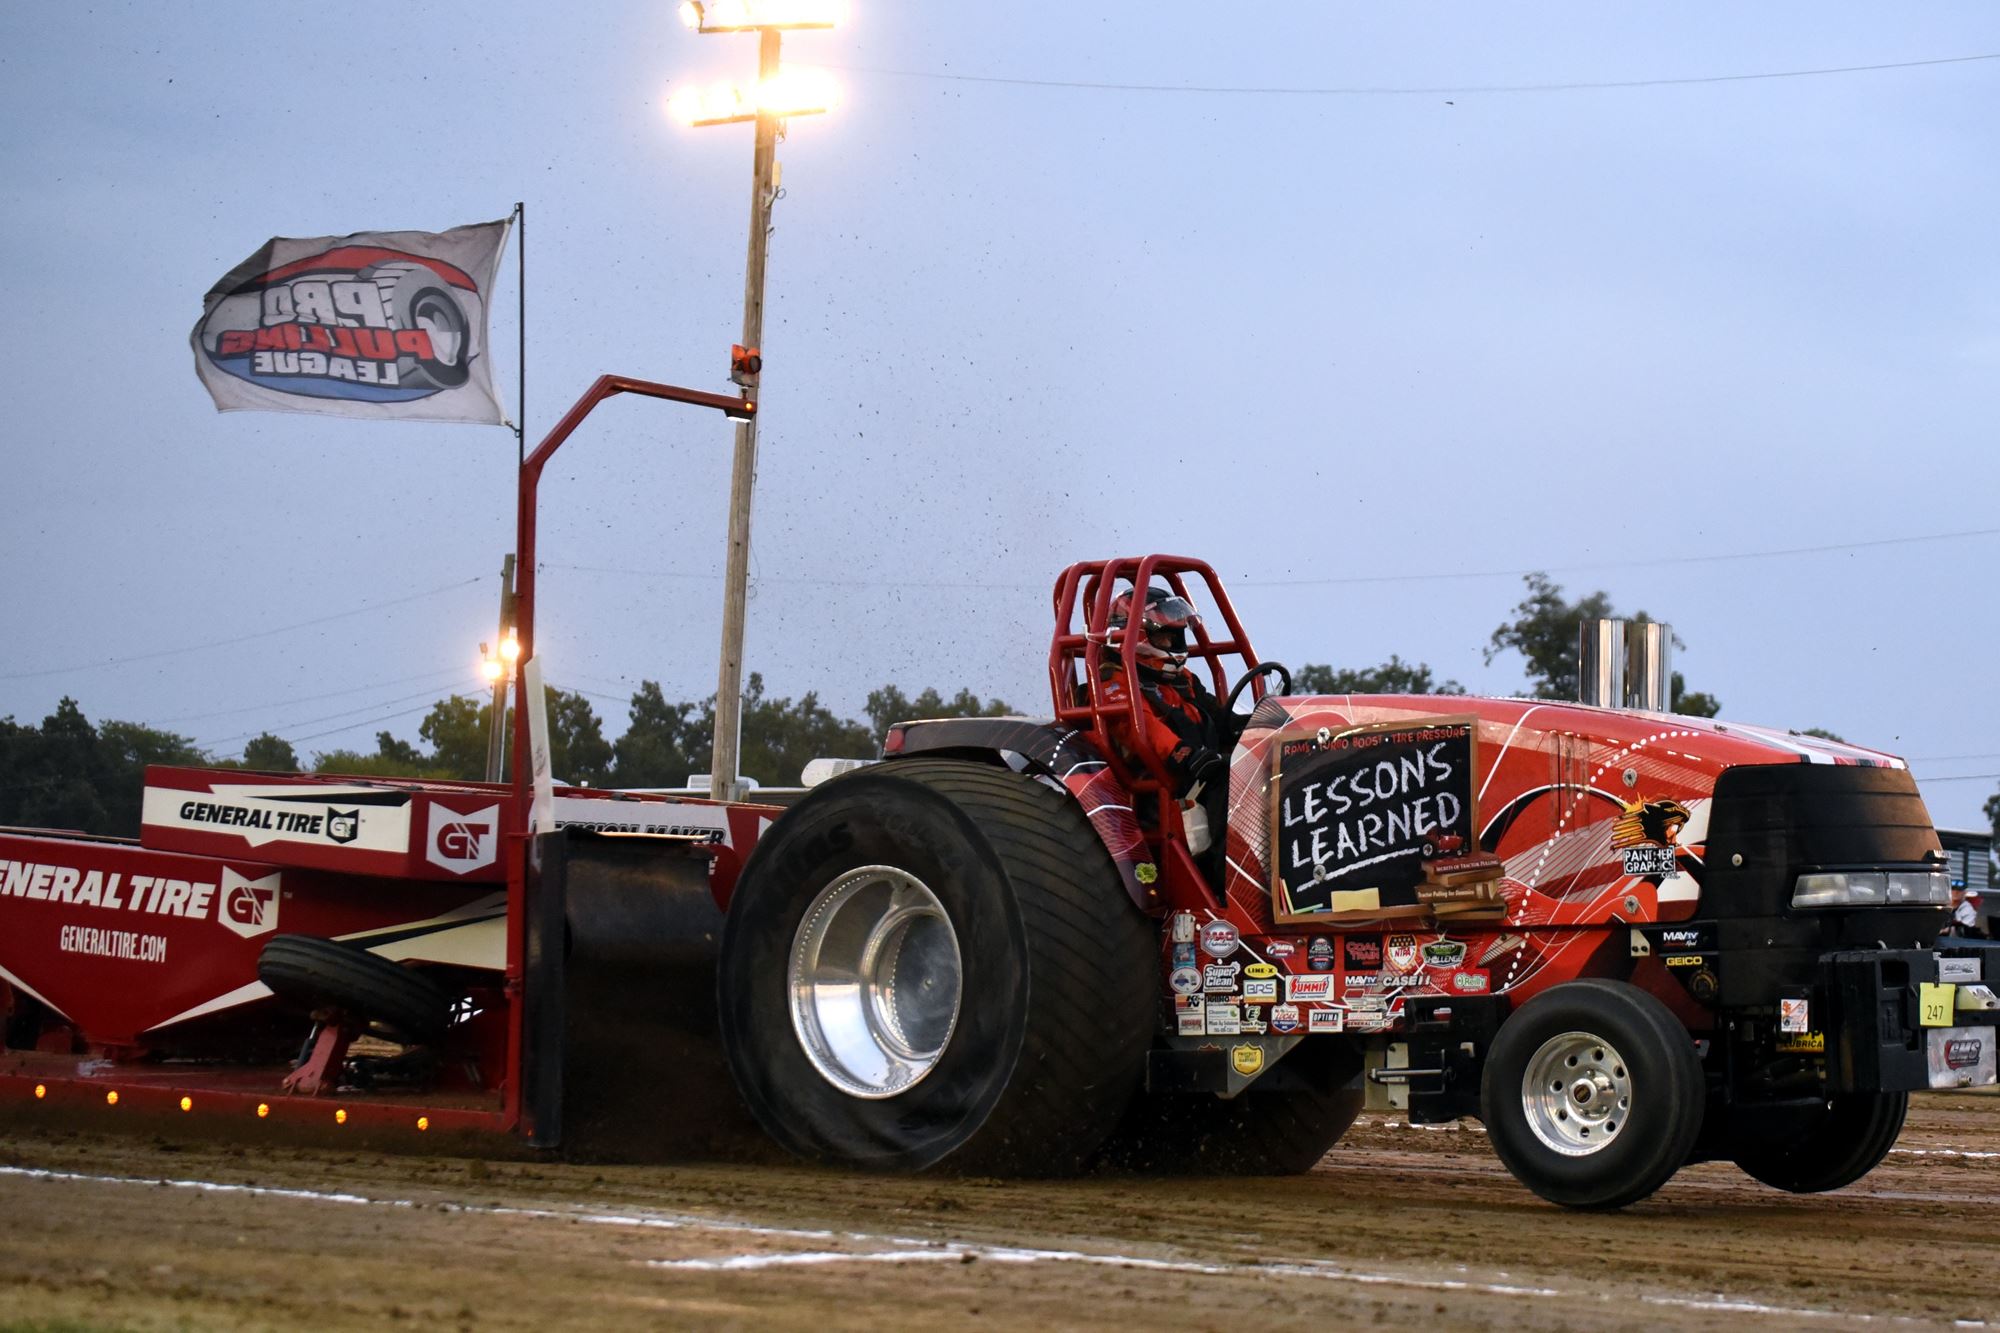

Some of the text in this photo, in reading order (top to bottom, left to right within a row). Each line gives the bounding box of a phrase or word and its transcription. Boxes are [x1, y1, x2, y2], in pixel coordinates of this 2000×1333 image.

[1352, 734, 1382, 748] BOOST
[1391, 731, 1414, 743] TIRE
[1416, 727, 1466, 742] PRESSURE
[1283, 741, 1453, 827] LESSONS
[179, 801, 273, 829] GENERAL
[275, 811, 324, 835] TIRE
[1291, 791, 1461, 868] LEARNED
[1625, 849, 1673, 862] PANTHER
[1625, 860, 1674, 873] GRAPHICS
[128, 874, 217, 920] TIRE
[1663, 931, 1699, 941] MAVTV
[60, 925, 167, 963] GENERALTIRE.COM
[1394, 947, 1412, 958] NTPA
[1425, 955, 1462, 964] CHALLENGE
[1666, 956, 1703, 966] GEICO
[1205, 967, 1236, 977] Super
[1206, 976, 1233, 987] Clean
[1345, 975, 1377, 986] MAVTV
[1383, 975, 1418, 987] CASE
[1246, 983, 1273, 994] BRS
[1312, 1012, 1339, 1022] OPTIMA
[1926, 1004, 1944, 1021] 247
